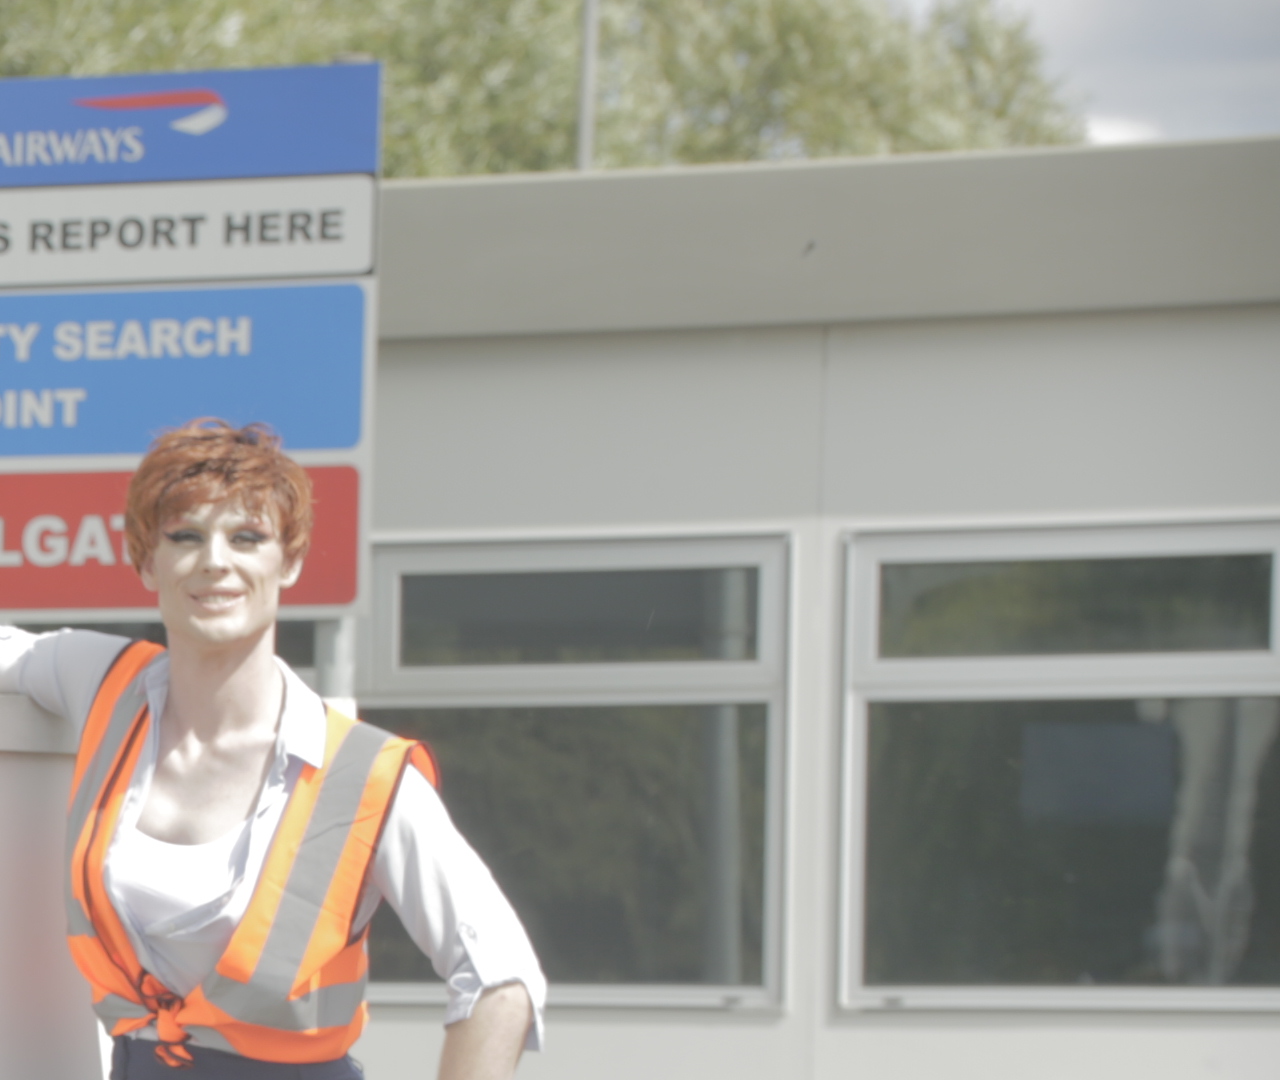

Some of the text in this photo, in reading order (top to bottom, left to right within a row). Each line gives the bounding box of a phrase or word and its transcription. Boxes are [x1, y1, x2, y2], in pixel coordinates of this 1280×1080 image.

[30, 215, 206, 252] REPORT
[224, 209, 344, 245] HERE
[54, 316, 252, 361] SEARCH
